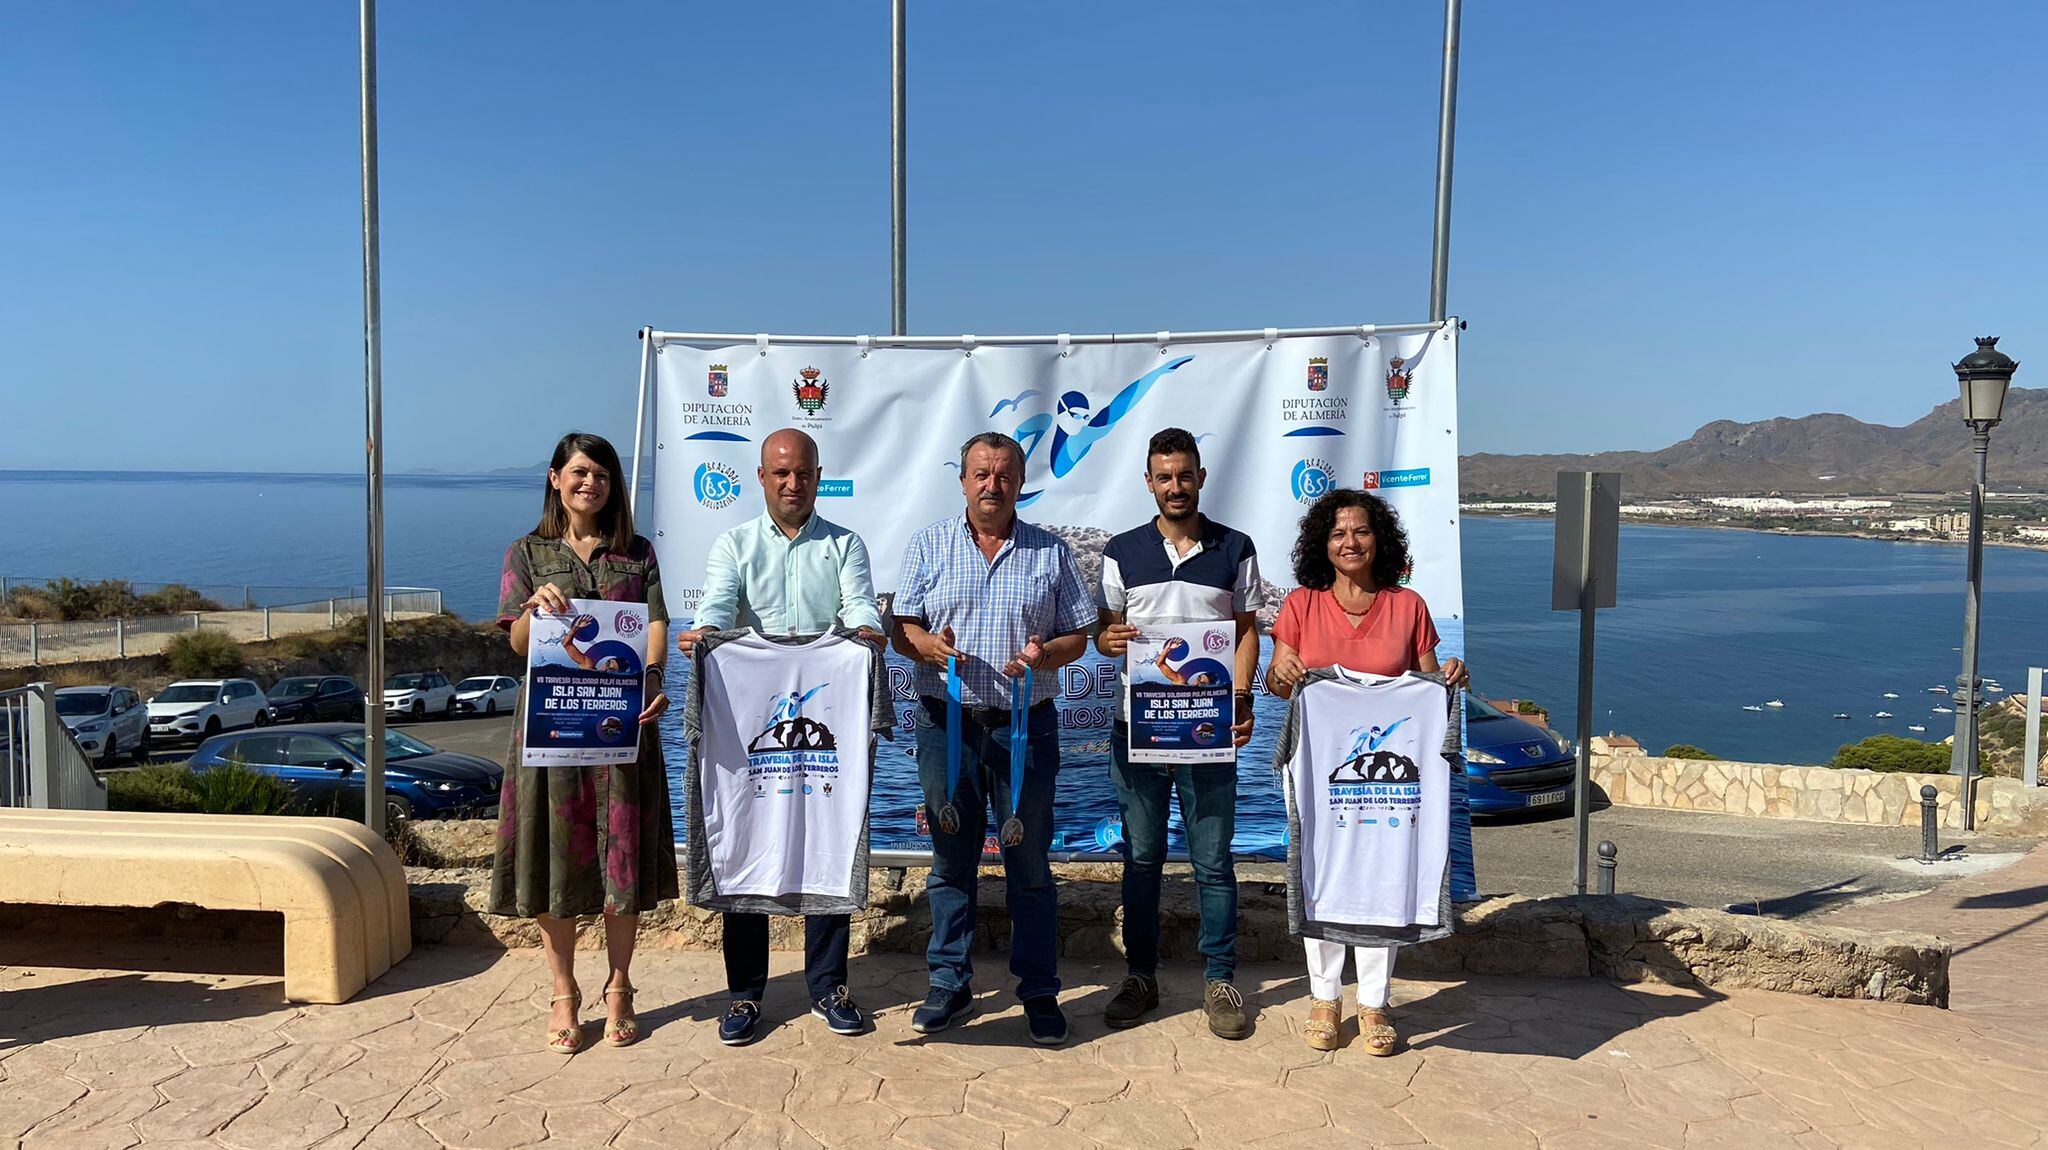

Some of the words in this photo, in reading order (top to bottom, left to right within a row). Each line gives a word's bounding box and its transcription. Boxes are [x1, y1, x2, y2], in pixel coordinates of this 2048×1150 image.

[682, 402, 752, 415] DIPUTACIÓN
[1282, 397, 1348, 409] DIPUTACIÓN
[684, 414, 698, 424] DE
[701, 415, 751, 426] ALMERÍA
[1283, 411, 1297, 421] DE
[1300, 410, 1346, 420] ALMERÍA
[707, 462, 740, 485] BRAZADAS
[1306, 458, 1335, 480] BRAZADAS
[1064, 663, 1116, 699] DE
[552, 686, 574, 697] ISLA
[576, 686, 595, 697] SAN
[598, 686, 622, 698] JUAN
[545, 698, 558, 710] DE
[560, 699, 579, 710] LOS
[582, 700, 627, 710] TERREROS
[1150, 699, 1170, 709] ISLA
[1172, 699, 1189, 709] SAN
[1191, 698, 1213, 708] JUAN
[1062, 706, 1106, 730] LOS
[1145, 710, 1156, 719] DE
[1158, 710, 1175, 719] LOS
[1178, 708, 1219, 719] TERREROS
[748, 756, 791, 767] TRAVESÍA
[793, 754, 803, 762] DE
[804, 754, 816, 762] LA
[818, 754, 839, 764] ISLA
[748, 768, 762, 776] SAN
[764, 766, 781, 774] JUAN
[803, 764, 839, 772] TERREROS
[1328, 786, 1373, 796] TRAVESÍA
[1375, 787, 1388, 795] DE
[1389, 787, 1402, 795] LA
[1404, 786, 1421, 795] ISLA
